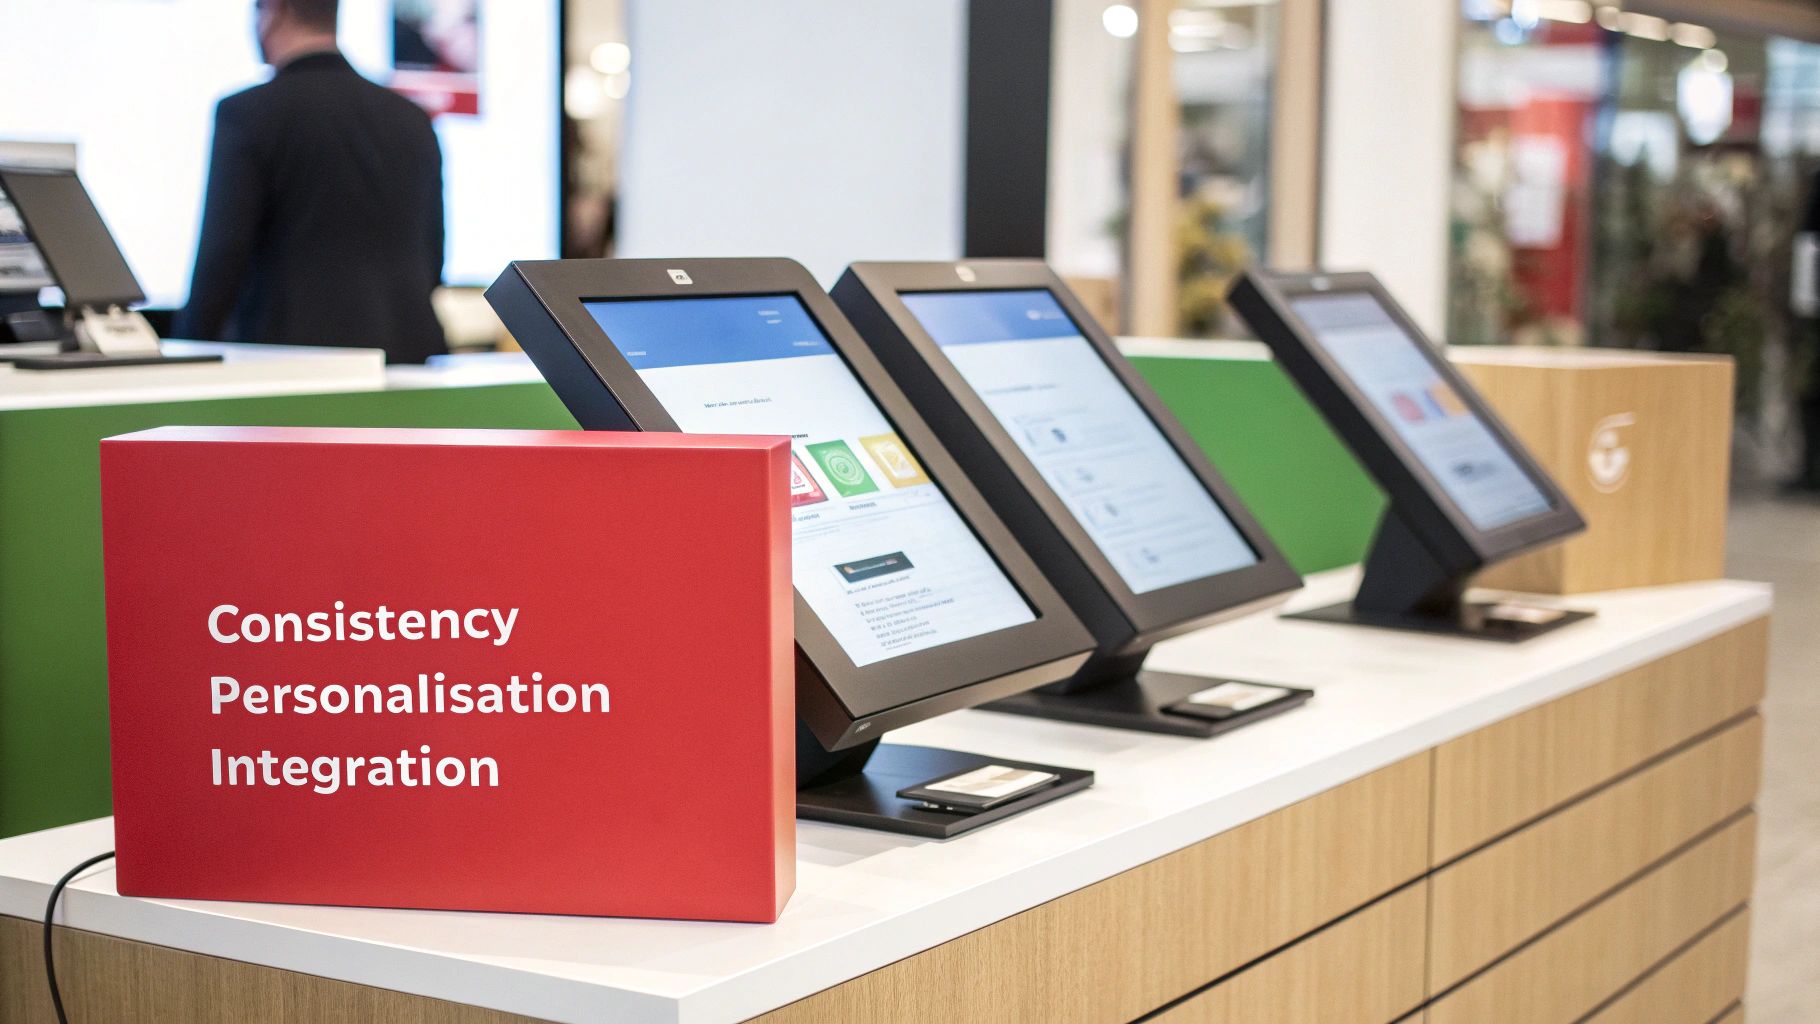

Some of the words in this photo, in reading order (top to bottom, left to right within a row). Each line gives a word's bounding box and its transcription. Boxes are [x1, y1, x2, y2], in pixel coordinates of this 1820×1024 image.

[207, 600, 520, 646] Consistency
[210, 672, 610, 715] Personalisation
[211, 745, 499, 795] Integration
